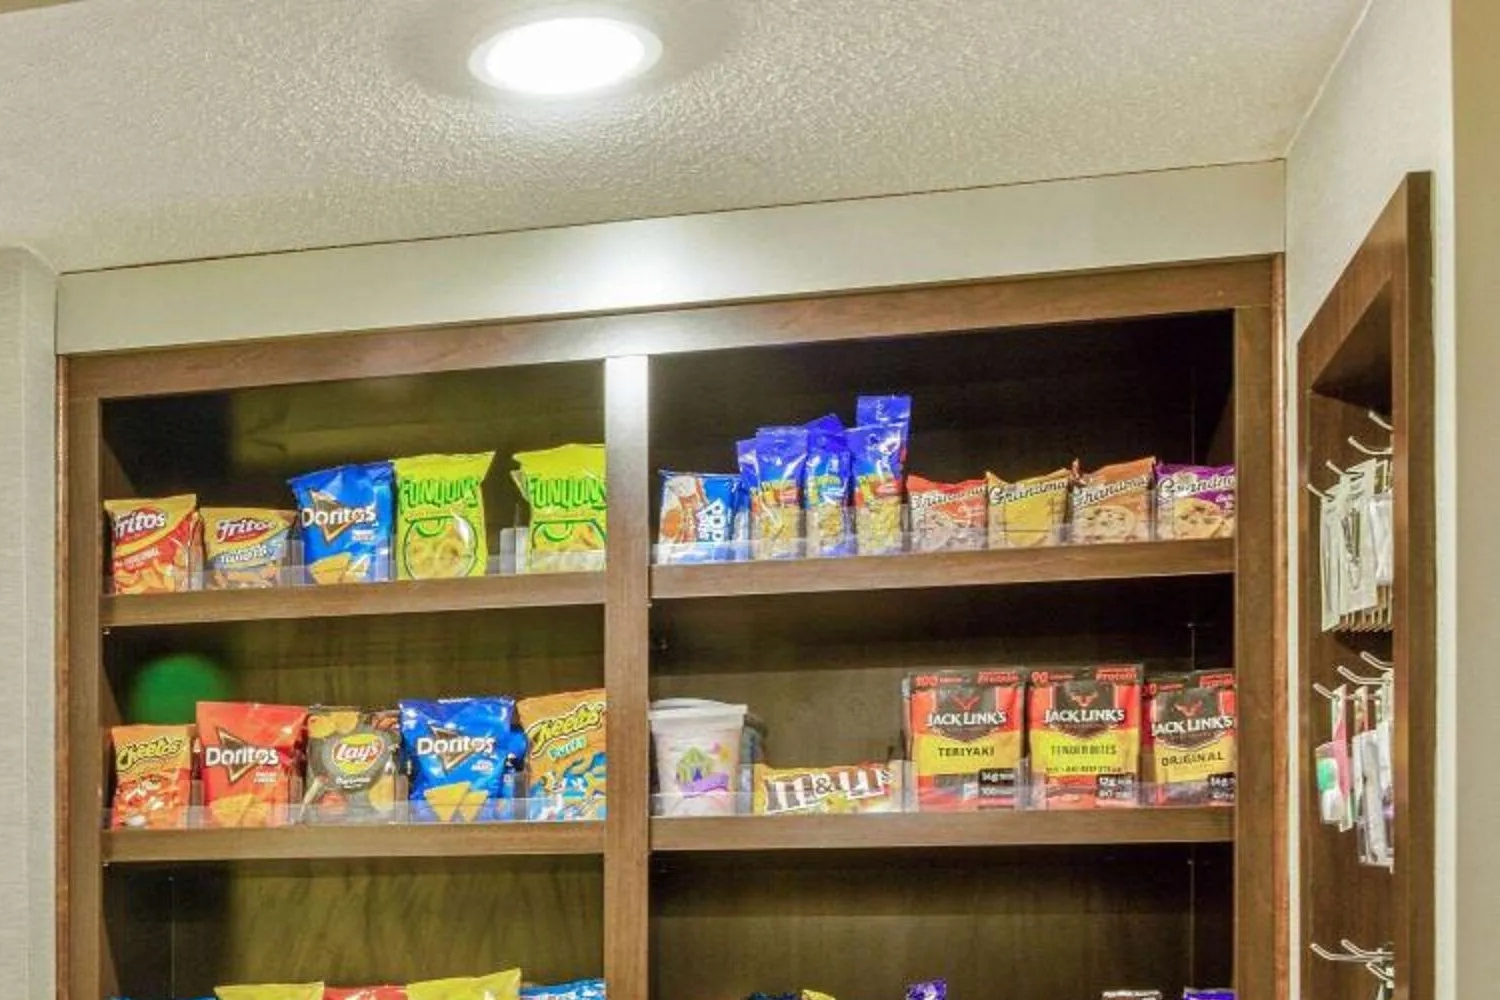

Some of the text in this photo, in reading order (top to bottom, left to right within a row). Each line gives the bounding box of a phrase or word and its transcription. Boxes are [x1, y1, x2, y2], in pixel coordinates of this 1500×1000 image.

[302, 504, 377, 527] Doritos
[927, 710, 1007, 728] JACK LINK'S
[1044, 708, 1125, 723] JACK LINK'S
[1151, 715, 1233, 738] JACK LINK'S
[416, 735, 497, 755] Doritos
[937, 747, 995, 758] TERIYAKI
[205, 746, 279, 766] Doritos
[1161, 752, 1225, 767] ORIGINAL
